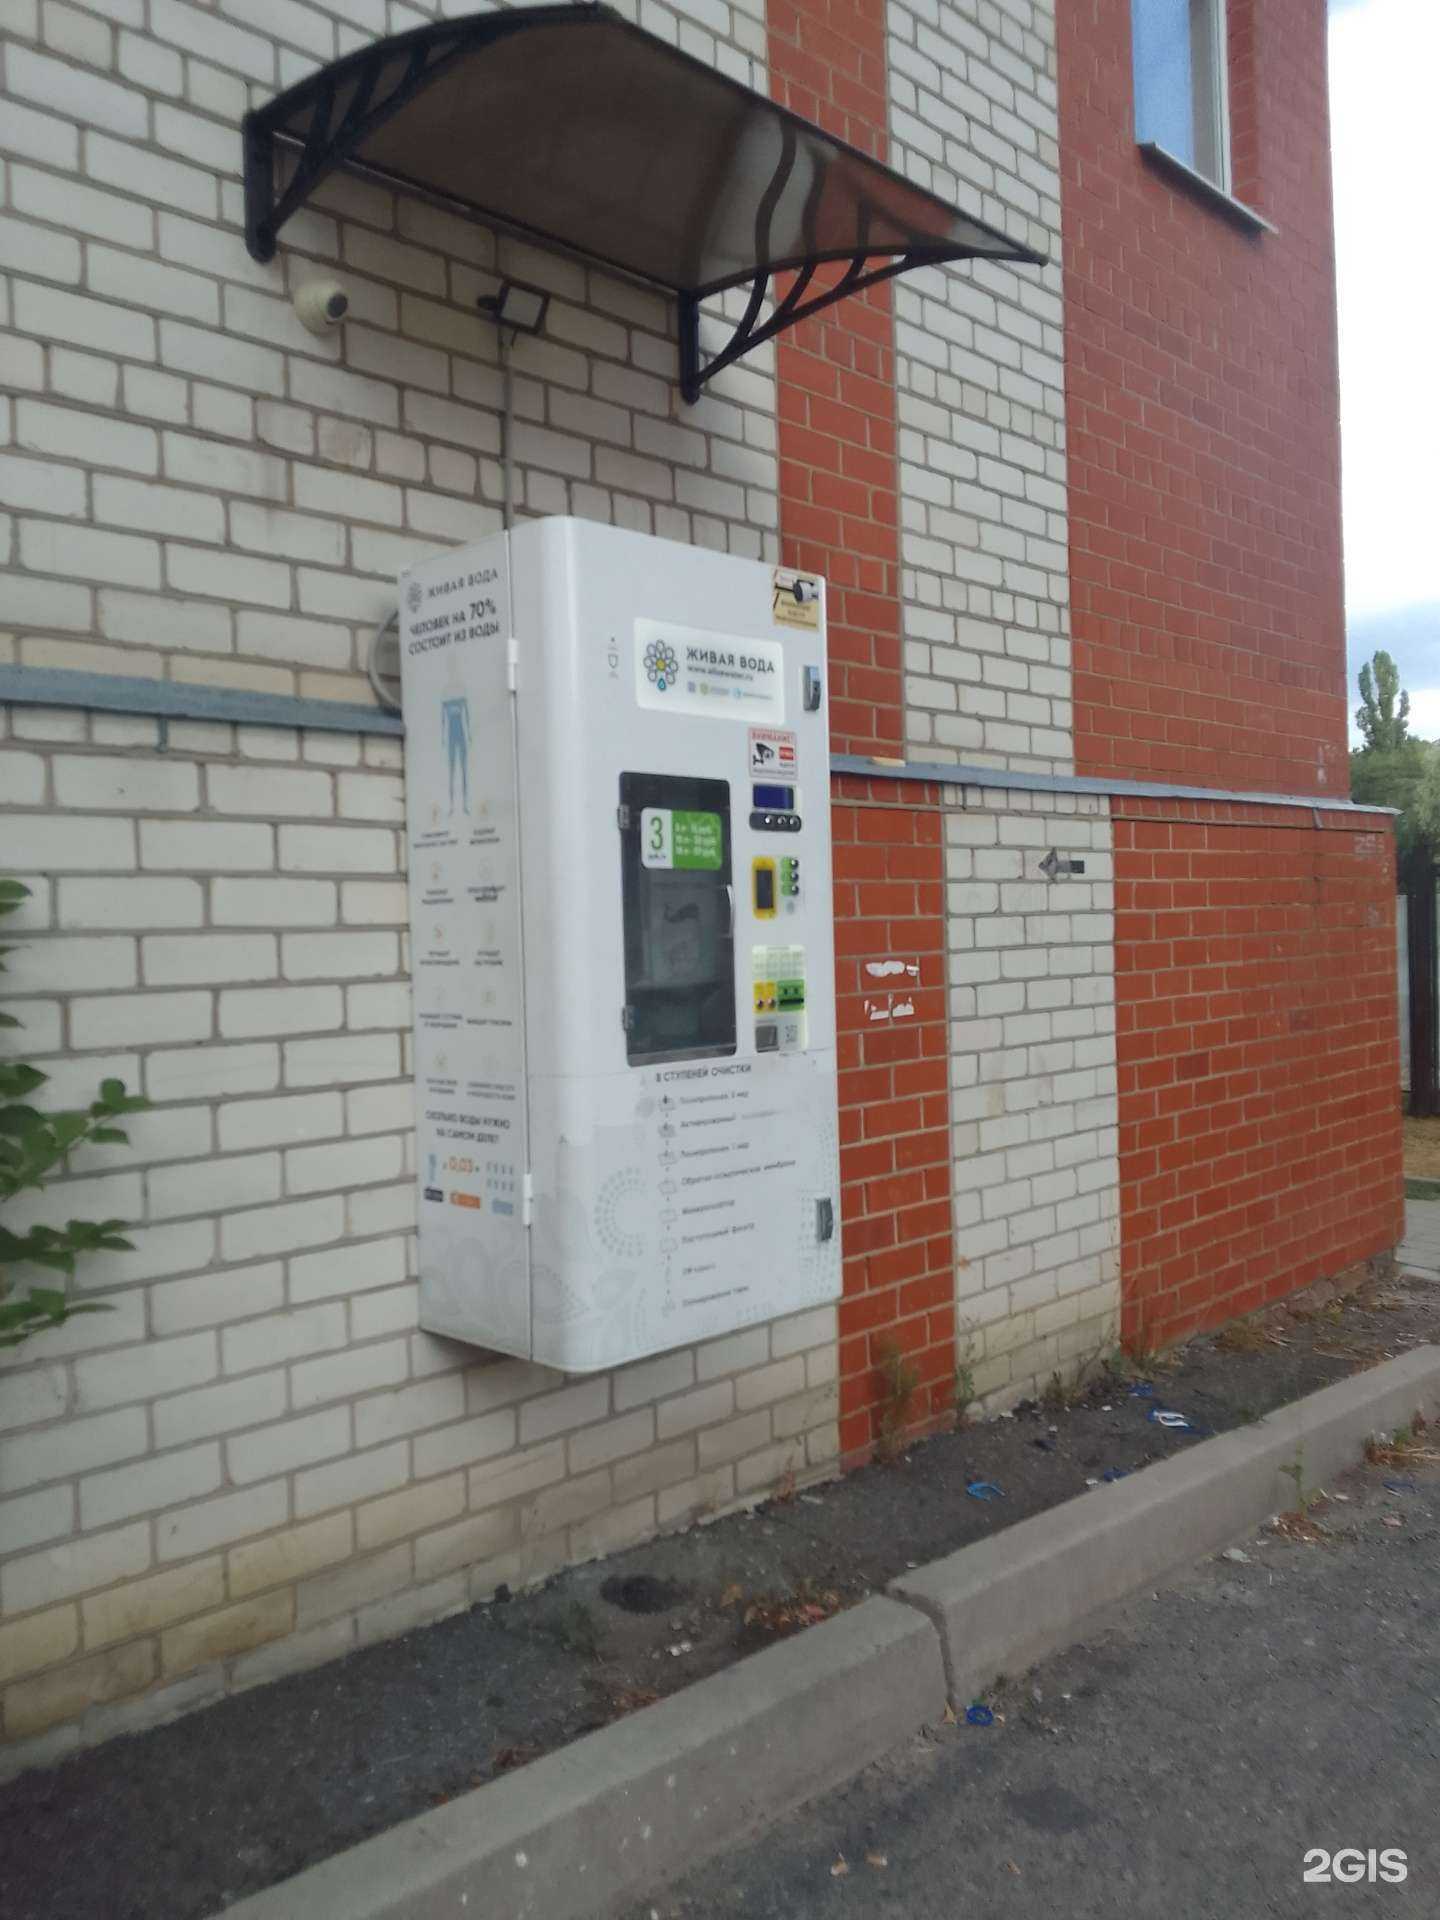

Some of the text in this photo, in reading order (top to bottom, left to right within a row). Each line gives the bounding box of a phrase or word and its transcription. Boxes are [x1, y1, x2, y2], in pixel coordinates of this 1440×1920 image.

[427, 568, 499, 598] ЖИВАЯ ВОДА
[468, 597, 497, 621] 70%
[685, 645, 776, 674] ЖИВАЯ ВОДА
[650, 816, 665, 851] 3
